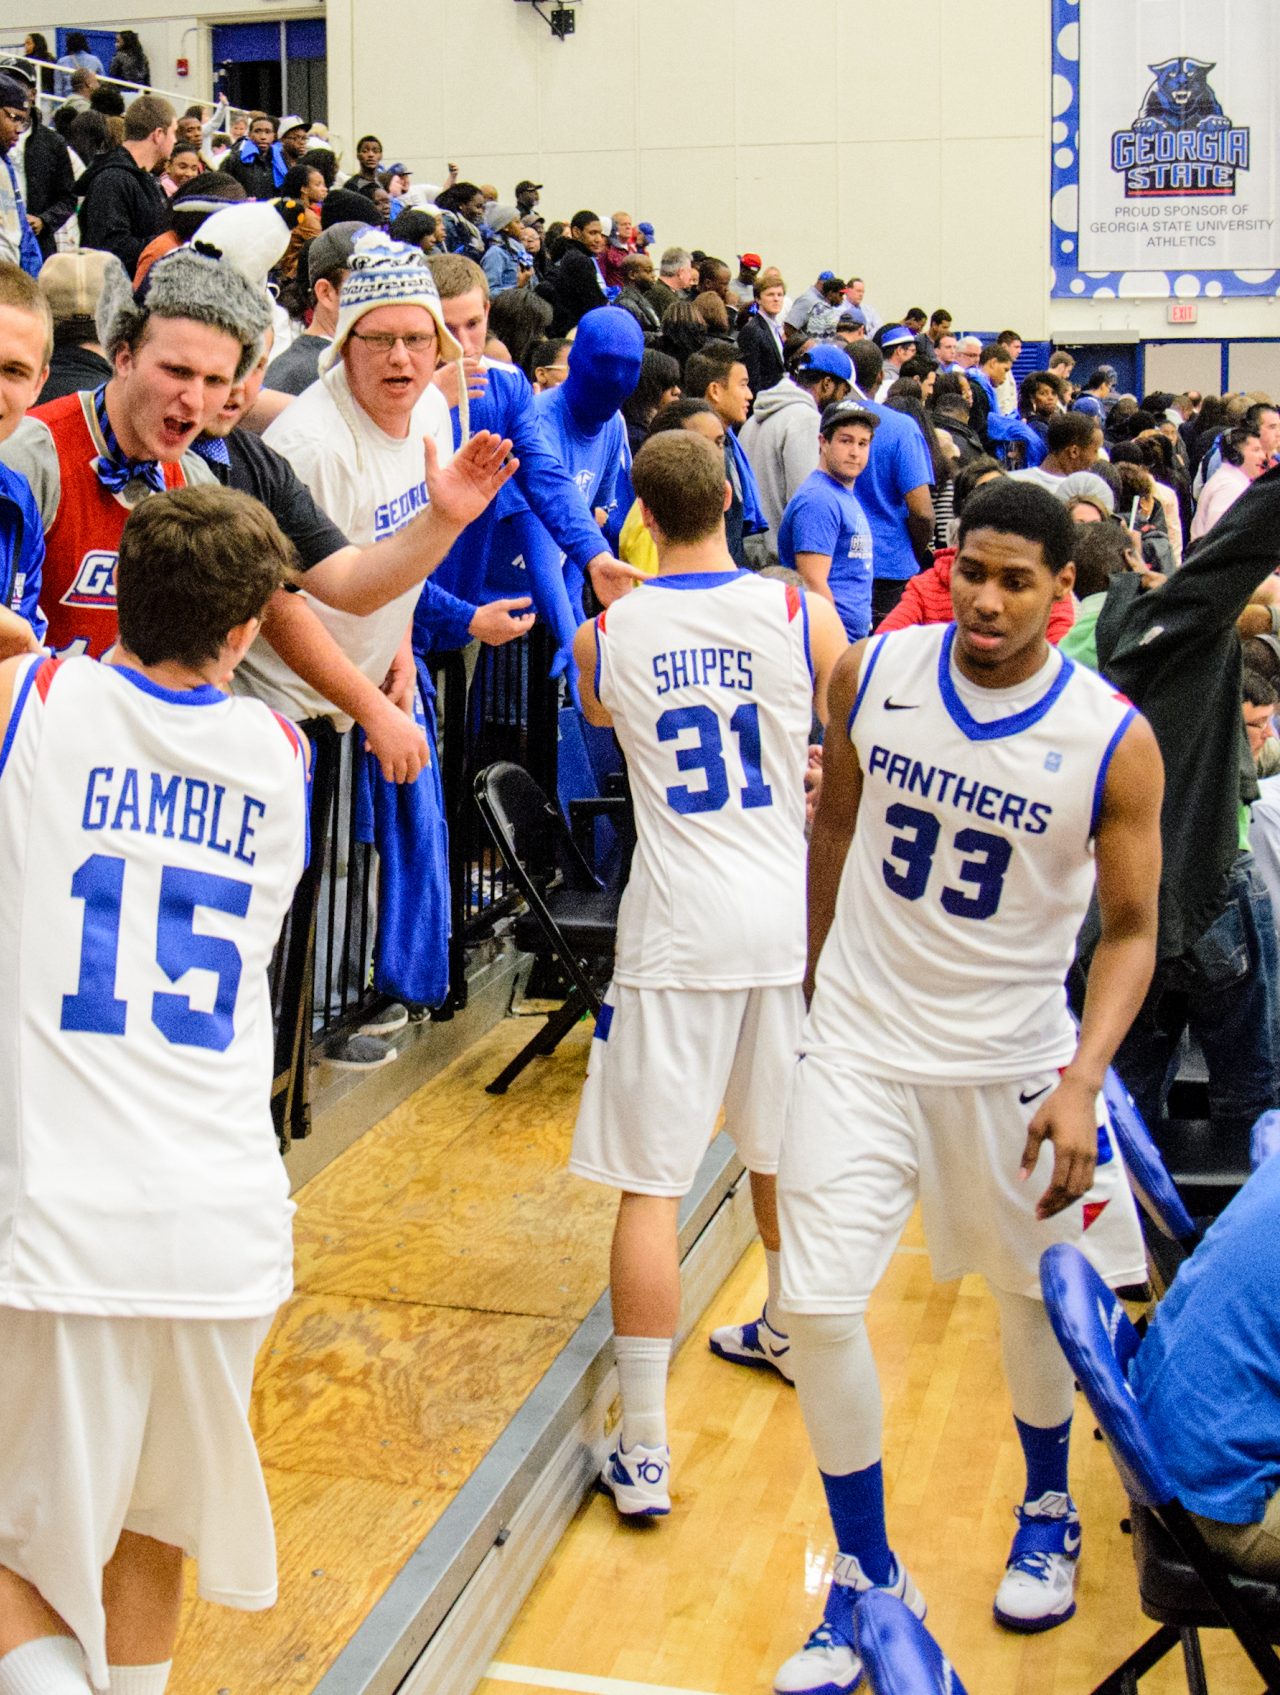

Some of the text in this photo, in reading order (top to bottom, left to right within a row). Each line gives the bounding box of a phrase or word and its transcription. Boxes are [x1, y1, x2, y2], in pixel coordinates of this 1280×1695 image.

[1113, 129, 1249, 171] GEORGIA
[1128, 163, 1235, 189] STATE
[1090, 219, 1274, 233] GEORGIA STATE UNIVERSITY
[1114, 204, 1249, 218] PROUD SPONSOR OF
[1146, 236, 1216, 247] ATHLETICS
[1173, 306, 1193, 321] EXIT
[652, 648, 753, 696] SHIPES
[656, 702, 773, 815] 31
[869, 744, 1053, 835] PANTHERS
[82, 767, 266, 867] GAMBLE
[882, 802, 1014, 921] 33
[60, 853, 253, 1054] 15
